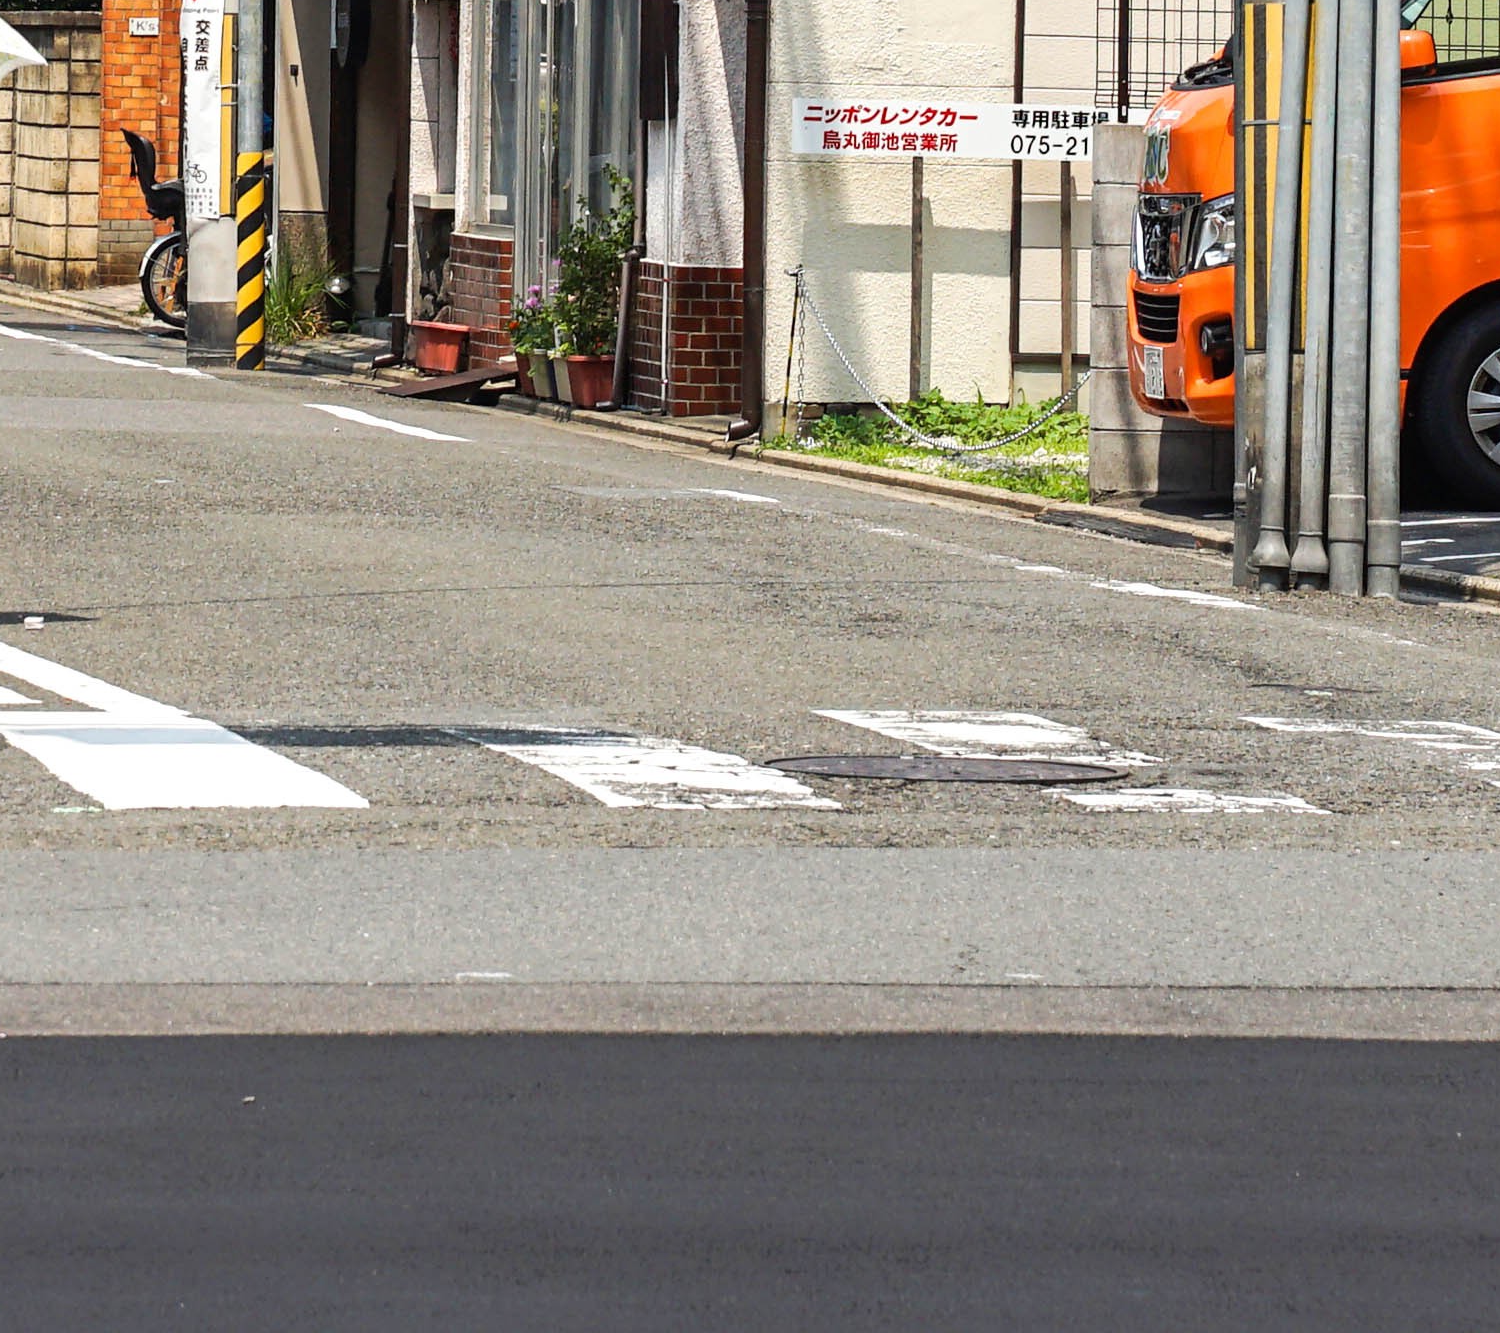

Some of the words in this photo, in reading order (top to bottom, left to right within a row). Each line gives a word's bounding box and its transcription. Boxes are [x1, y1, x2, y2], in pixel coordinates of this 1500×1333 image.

[195, 19, 212, 72] 交差点
[803, 105, 979, 127] ニッポンレンタカー
[1011, 109, 1110, 130] 専用駐車場
[822, 130, 958, 153] 烏丸御池営業所
[1010, 134, 1090, 157] 075-21
